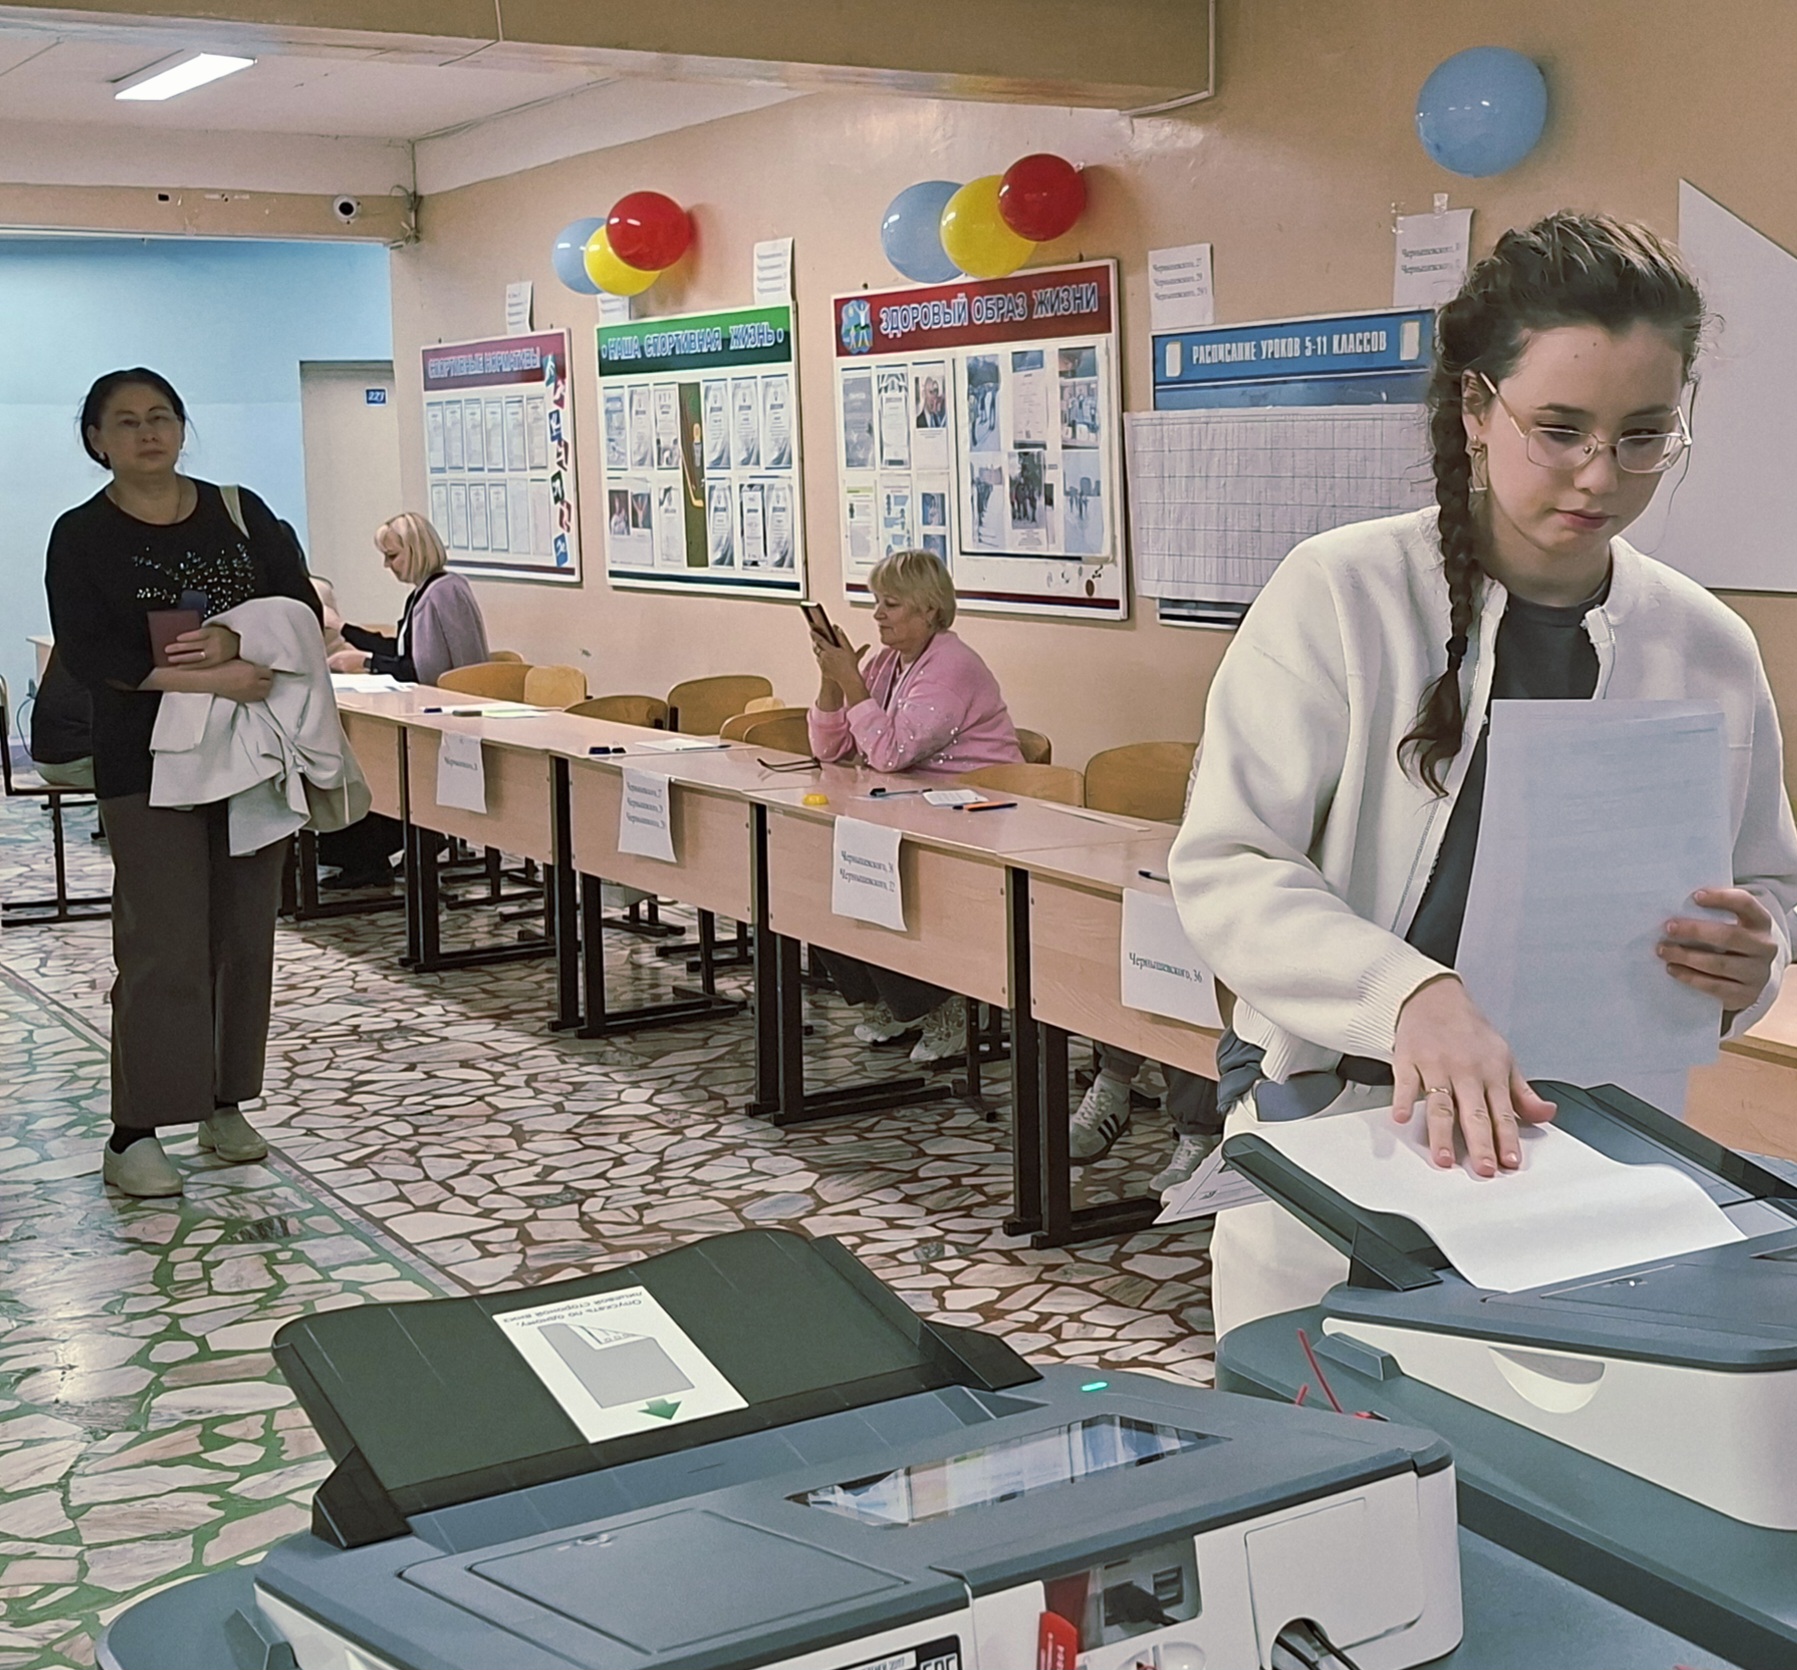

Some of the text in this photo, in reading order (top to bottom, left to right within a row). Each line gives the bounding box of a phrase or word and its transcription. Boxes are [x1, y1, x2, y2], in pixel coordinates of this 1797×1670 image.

[879, 282, 1099, 339] ЗДОРОВЫЙ ОБРАЗ ЖИЗНИ
[608, 322, 775, 360] НАША СПОРТИВНАЯ ЖИЗНЬ
[1192, 331, 1387, 365] РАСПИСАНИЕ УРОКОВ 5-11 КЛАССОВ
